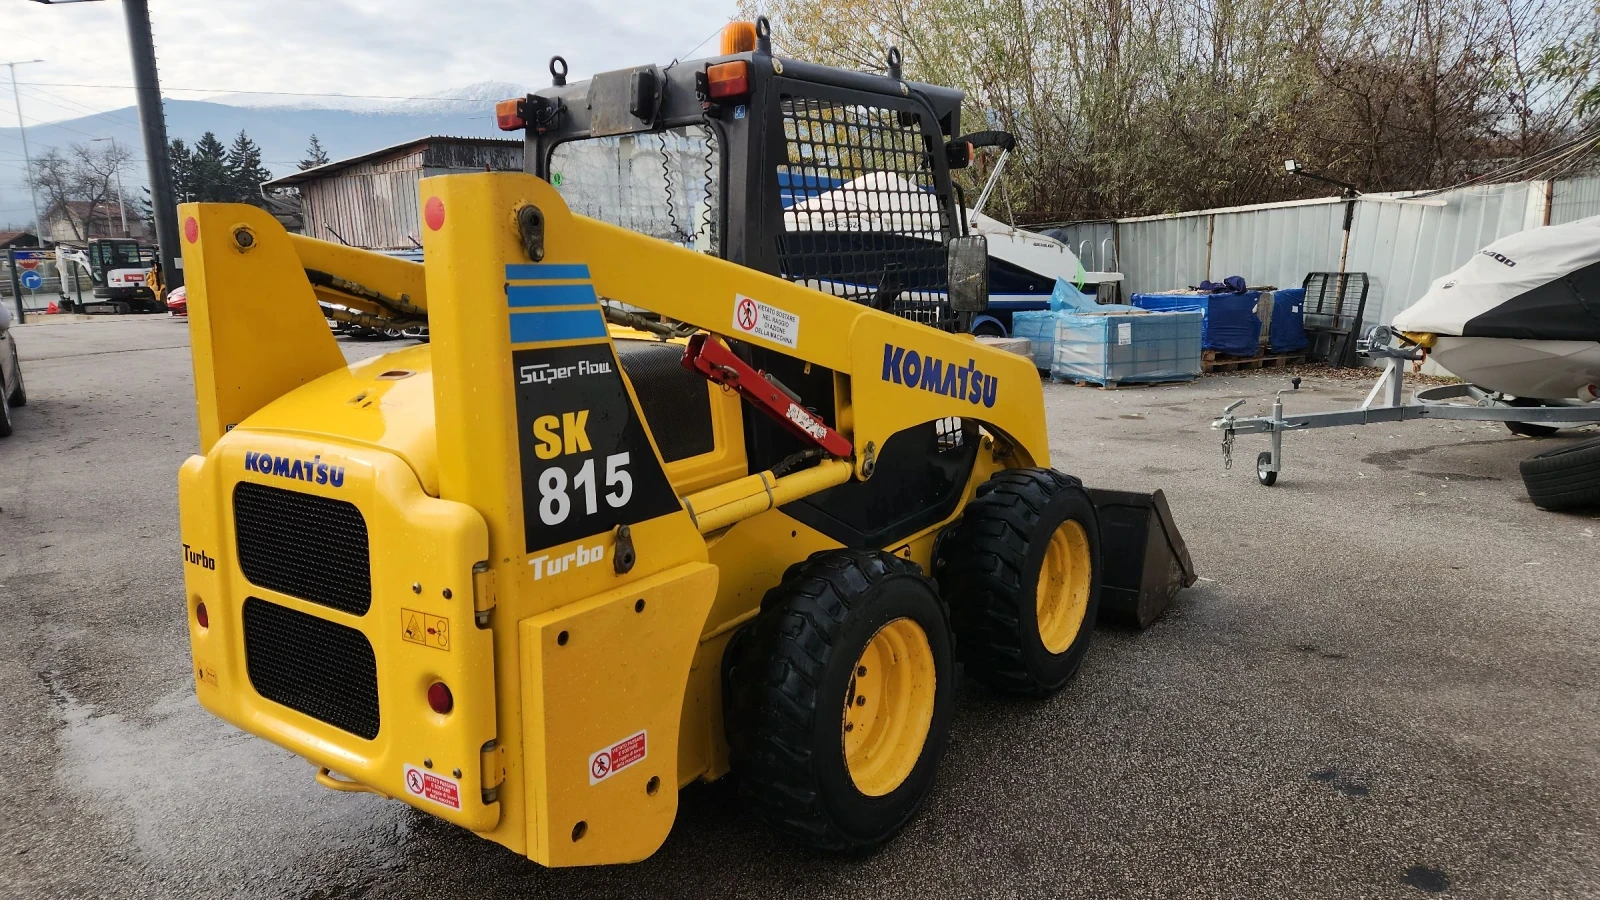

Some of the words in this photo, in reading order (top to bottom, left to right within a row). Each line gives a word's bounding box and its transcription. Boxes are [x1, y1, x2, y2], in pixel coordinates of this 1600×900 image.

[757, 303, 776, 316] VIETATO
[776, 310, 796, 323] SOSTARE
[762, 313, 771, 322] NEL
[772, 317, 790, 328] RAGGIO
[754, 326, 770, 337] DELLA
[770, 332, 793, 345] MACCHINA
[770, 324, 786, 335] AZIONE
[520, 363, 577, 384] Super
[578, 360, 612, 376] Flow
[881, 343, 998, 408] KOMATSU
[533, 409, 593, 460] SK
[245, 450, 345, 488] KOMATSU
[538, 451, 633, 526] 815
[183, 543, 216, 571] Turbo
[528, 544, 604, 581] Turbo
